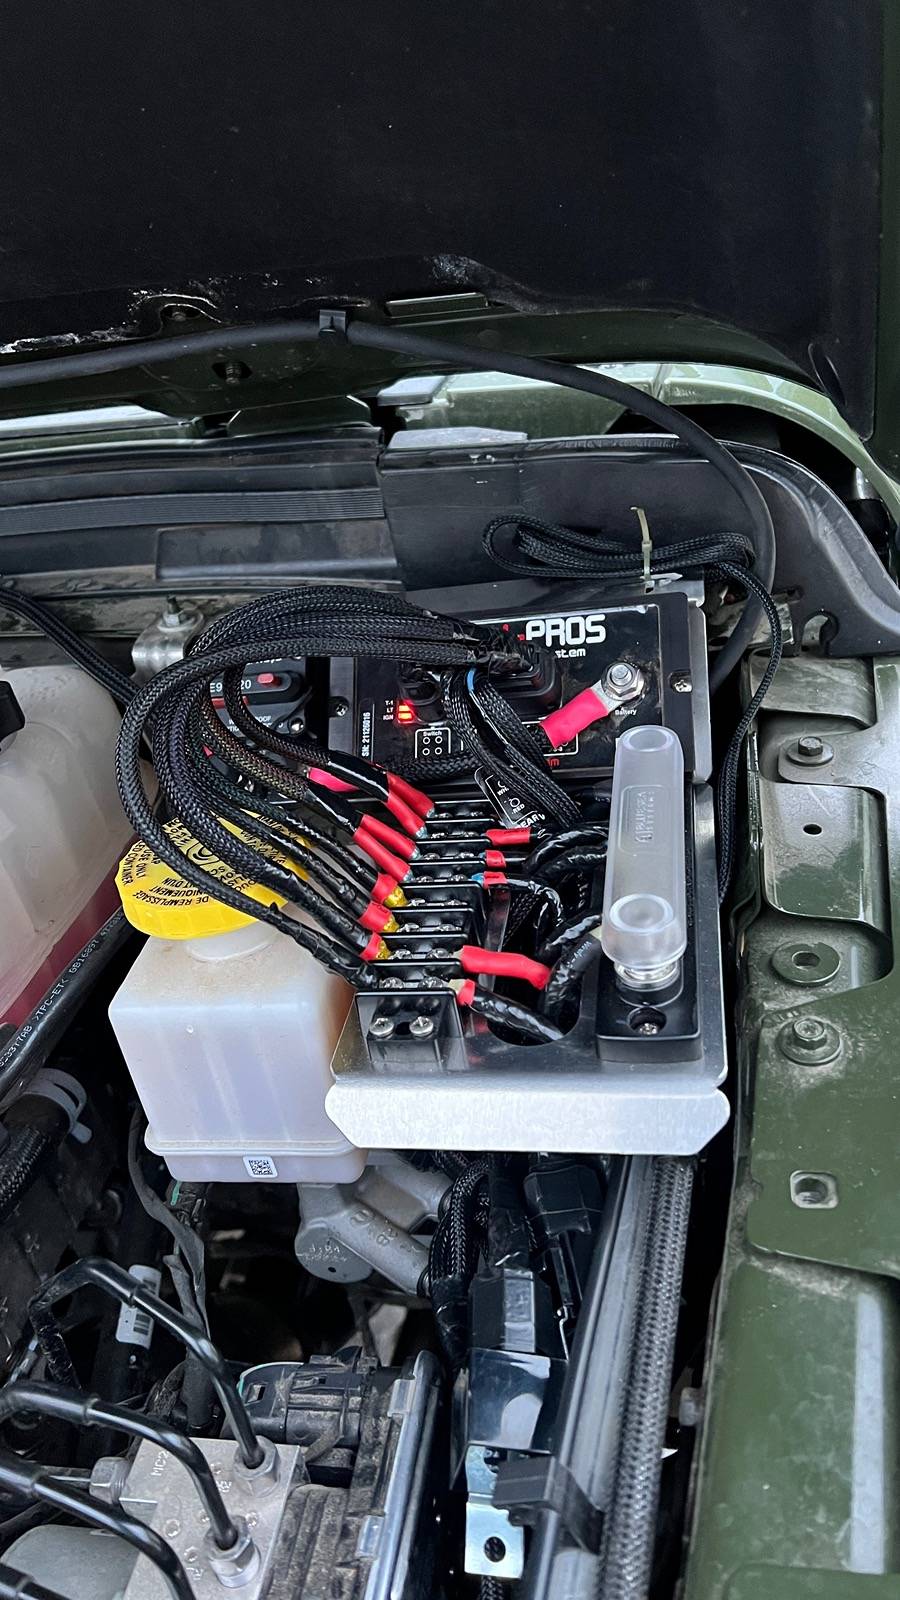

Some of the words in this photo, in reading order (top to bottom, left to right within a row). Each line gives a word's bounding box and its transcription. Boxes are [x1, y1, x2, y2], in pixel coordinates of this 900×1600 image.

[615, 708, 637, 716] Battery
[148, 886, 206, 897] NIQUEMENT
[132, 889, 193, 907] REMPLISSAGE
[197, 895, 209, 905] DE
